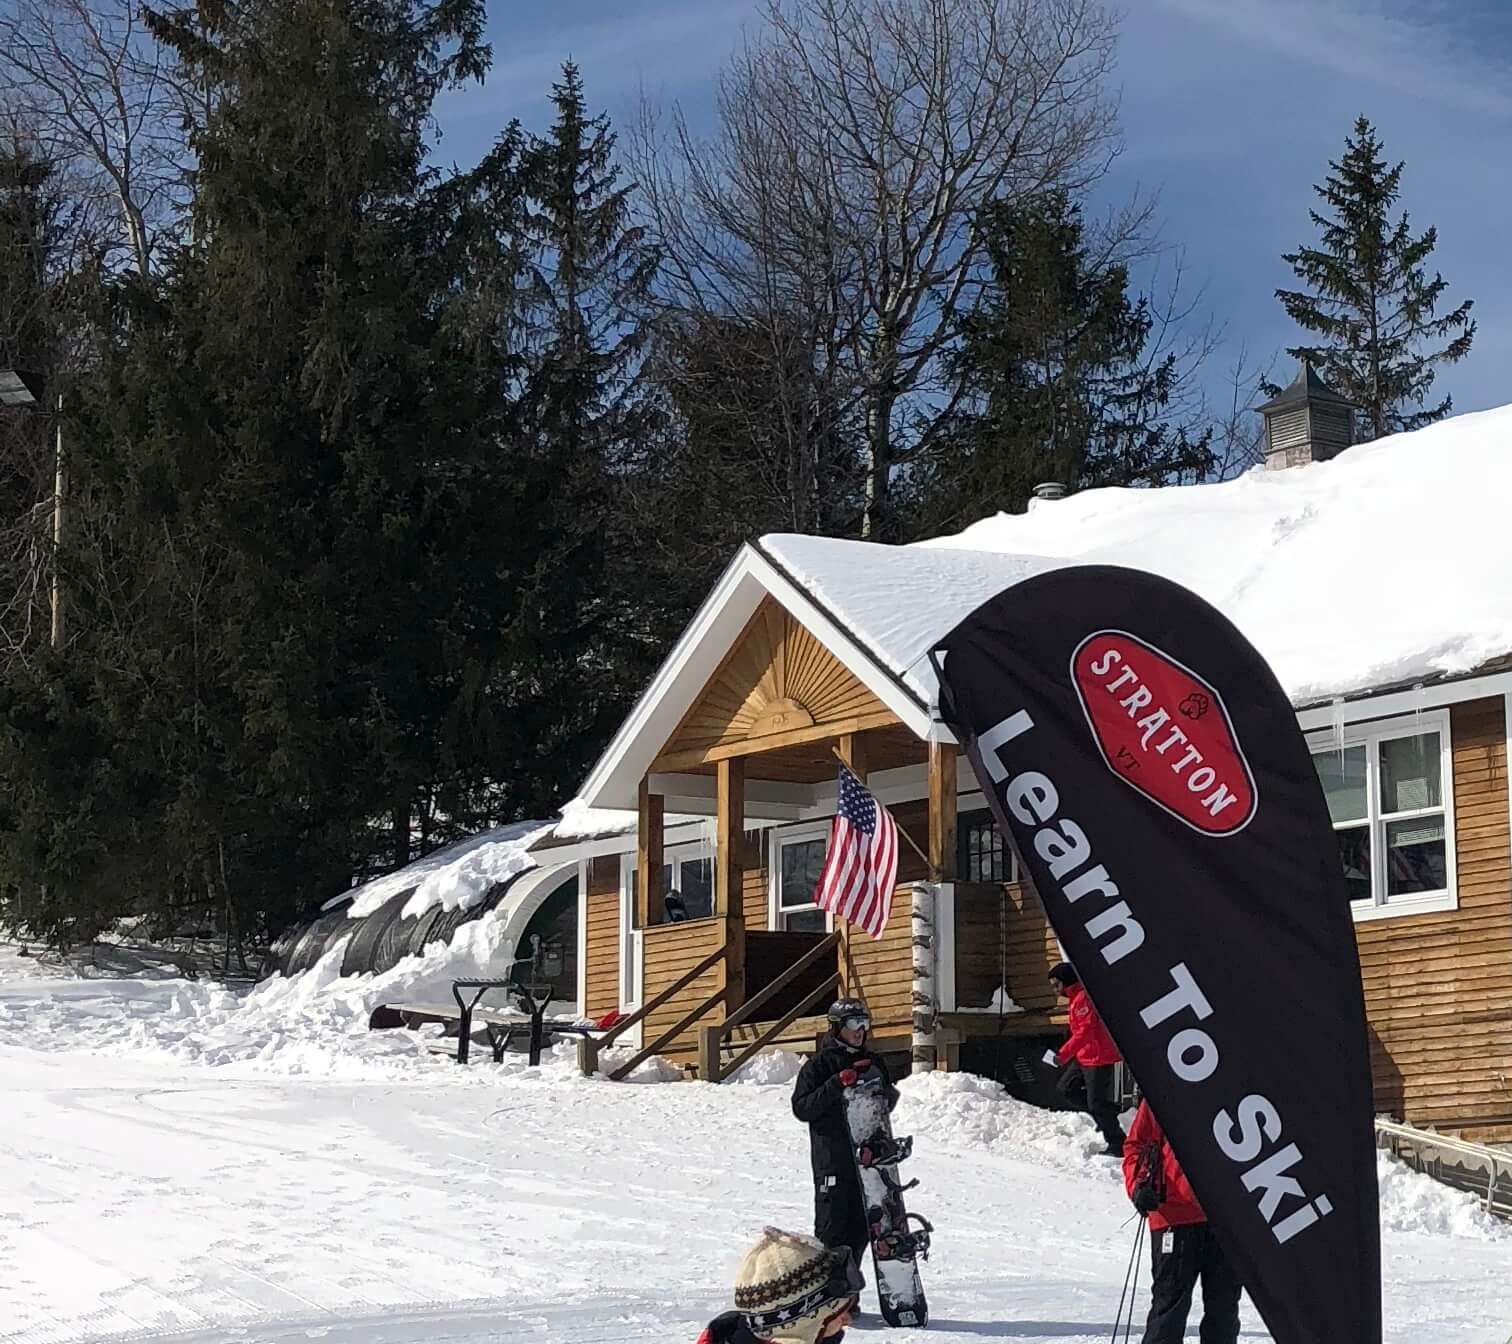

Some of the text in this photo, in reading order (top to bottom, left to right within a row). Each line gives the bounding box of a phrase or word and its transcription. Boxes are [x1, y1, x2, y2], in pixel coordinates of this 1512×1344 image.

[1090, 649, 1238, 817] STRATTON
[1115, 746, 1142, 771] VT
[977, 708, 1334, 1245] Learn To Ski
